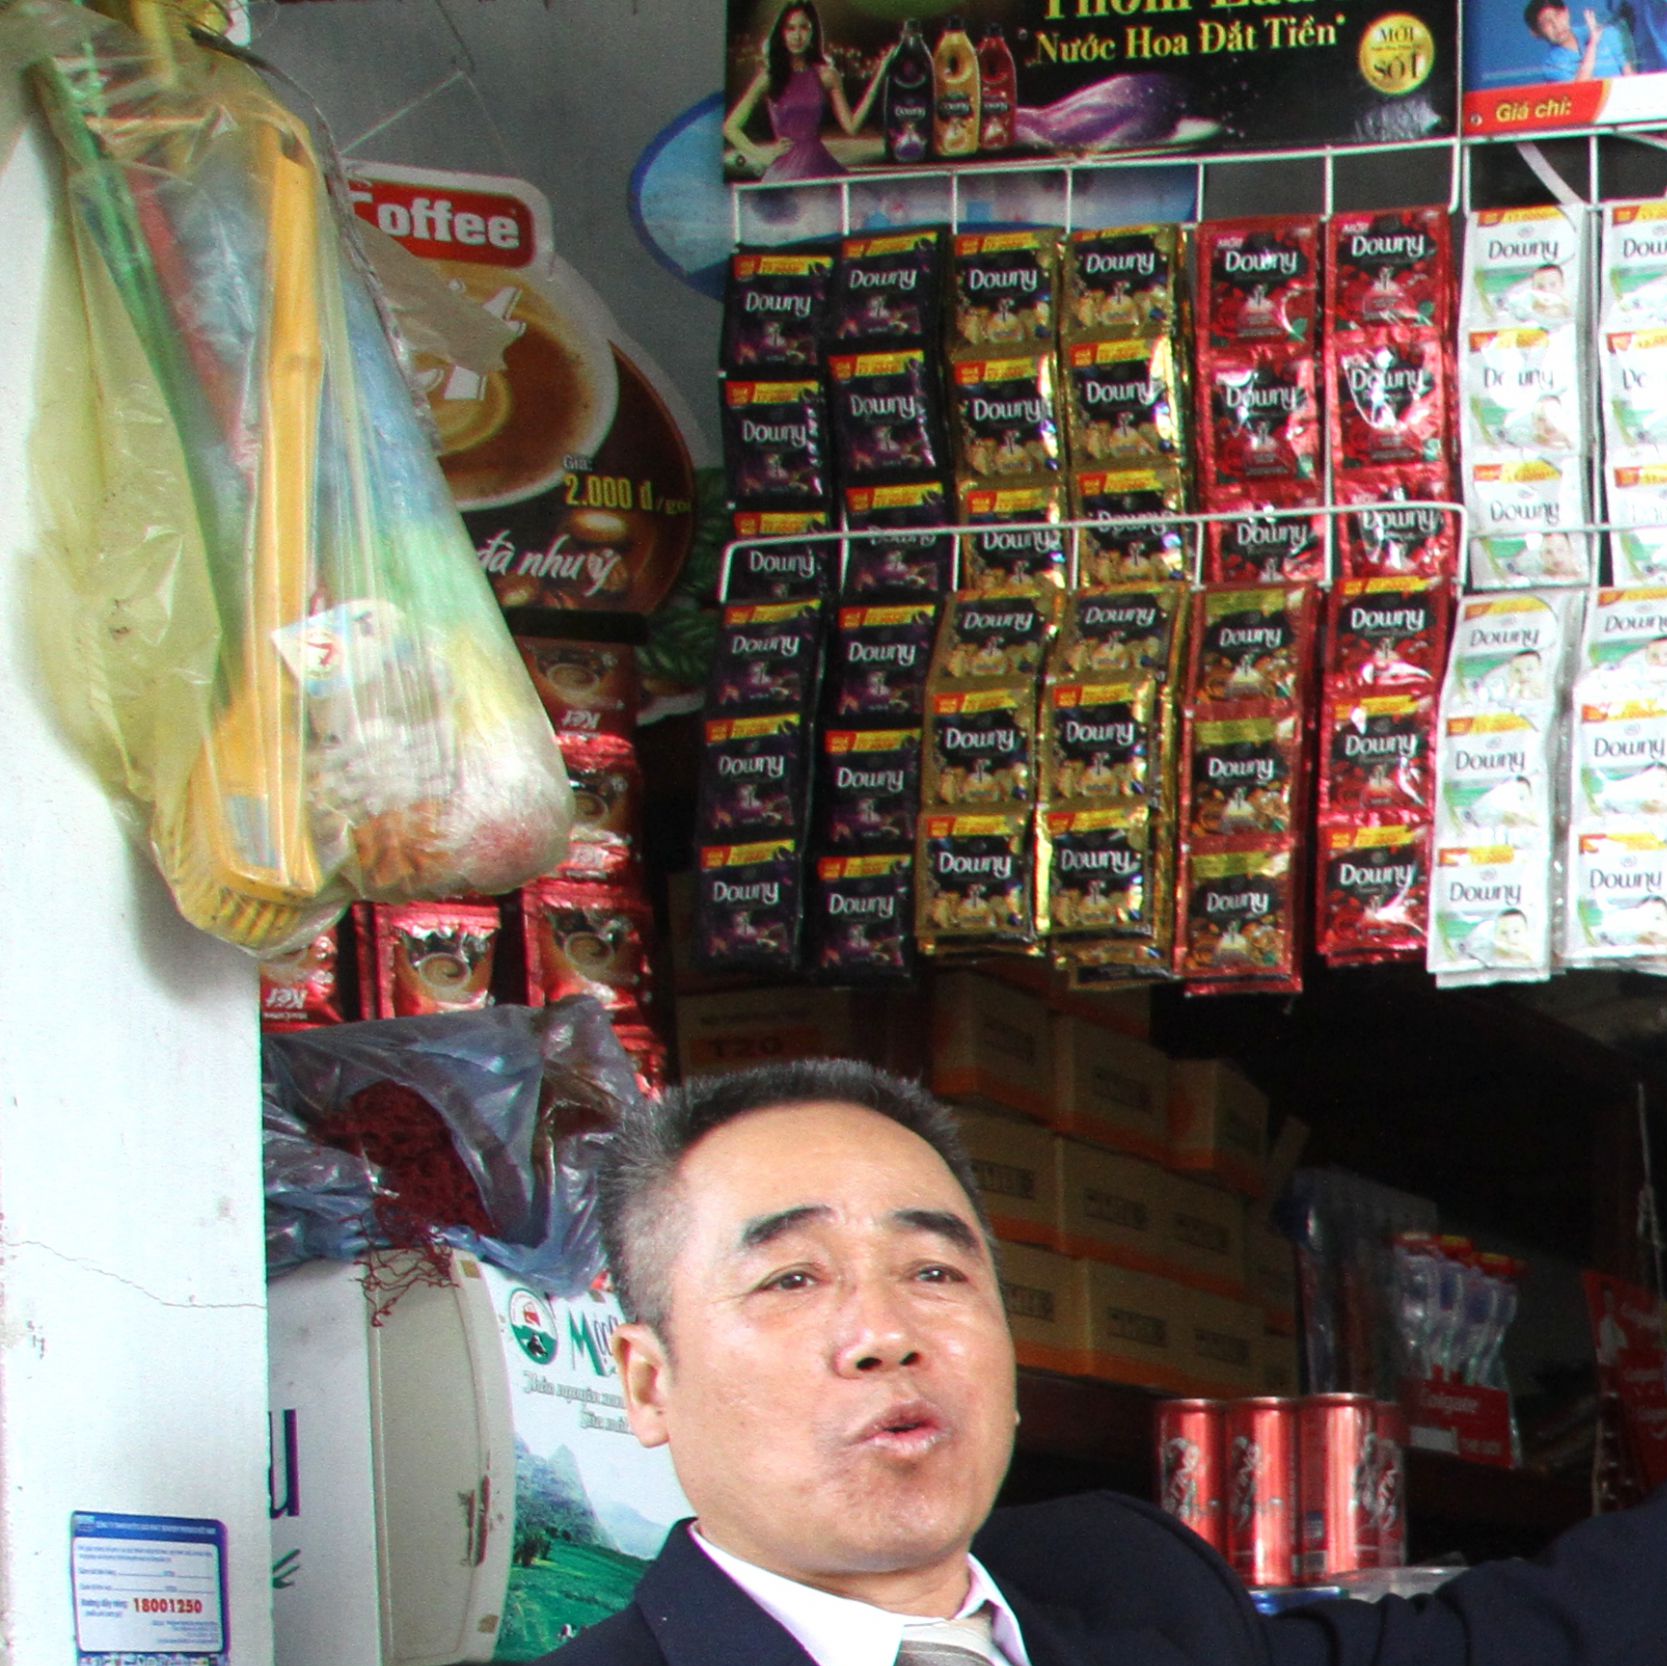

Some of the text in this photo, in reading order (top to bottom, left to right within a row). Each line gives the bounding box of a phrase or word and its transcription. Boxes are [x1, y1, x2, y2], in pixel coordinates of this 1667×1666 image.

[1037, 31, 1115, 65] Nước
[1125, 25, 1188, 58] Hoa
[1200, 19, 1259, 54] Đắt
[1496, 101, 1529, 122] Giá
[1351, 232, 1426, 262] Downy
[1488, 239, 1560, 264] Downy
[1085, 251, 1156, 279] Downy
[743, 290, 811, 319] Downy
[1085, 381, 1155, 409] Downy
[564, 477, 632, 509] 2.000
[1350, 606, 1426, 634] Downy
[731, 633, 800, 659] Downy
[1469, 625, 1541, 650] Downy
[945, 724, 1017, 752] Downy
[1455, 747, 1527, 774] Downy
[838, 765, 904, 793] Downy
[938, 850, 1012, 879] Downy
[1206, 888, 1270, 916] Downy
[1449, 879, 1522, 906] Downy
[133, 1598, 203, 1613] 18001250
